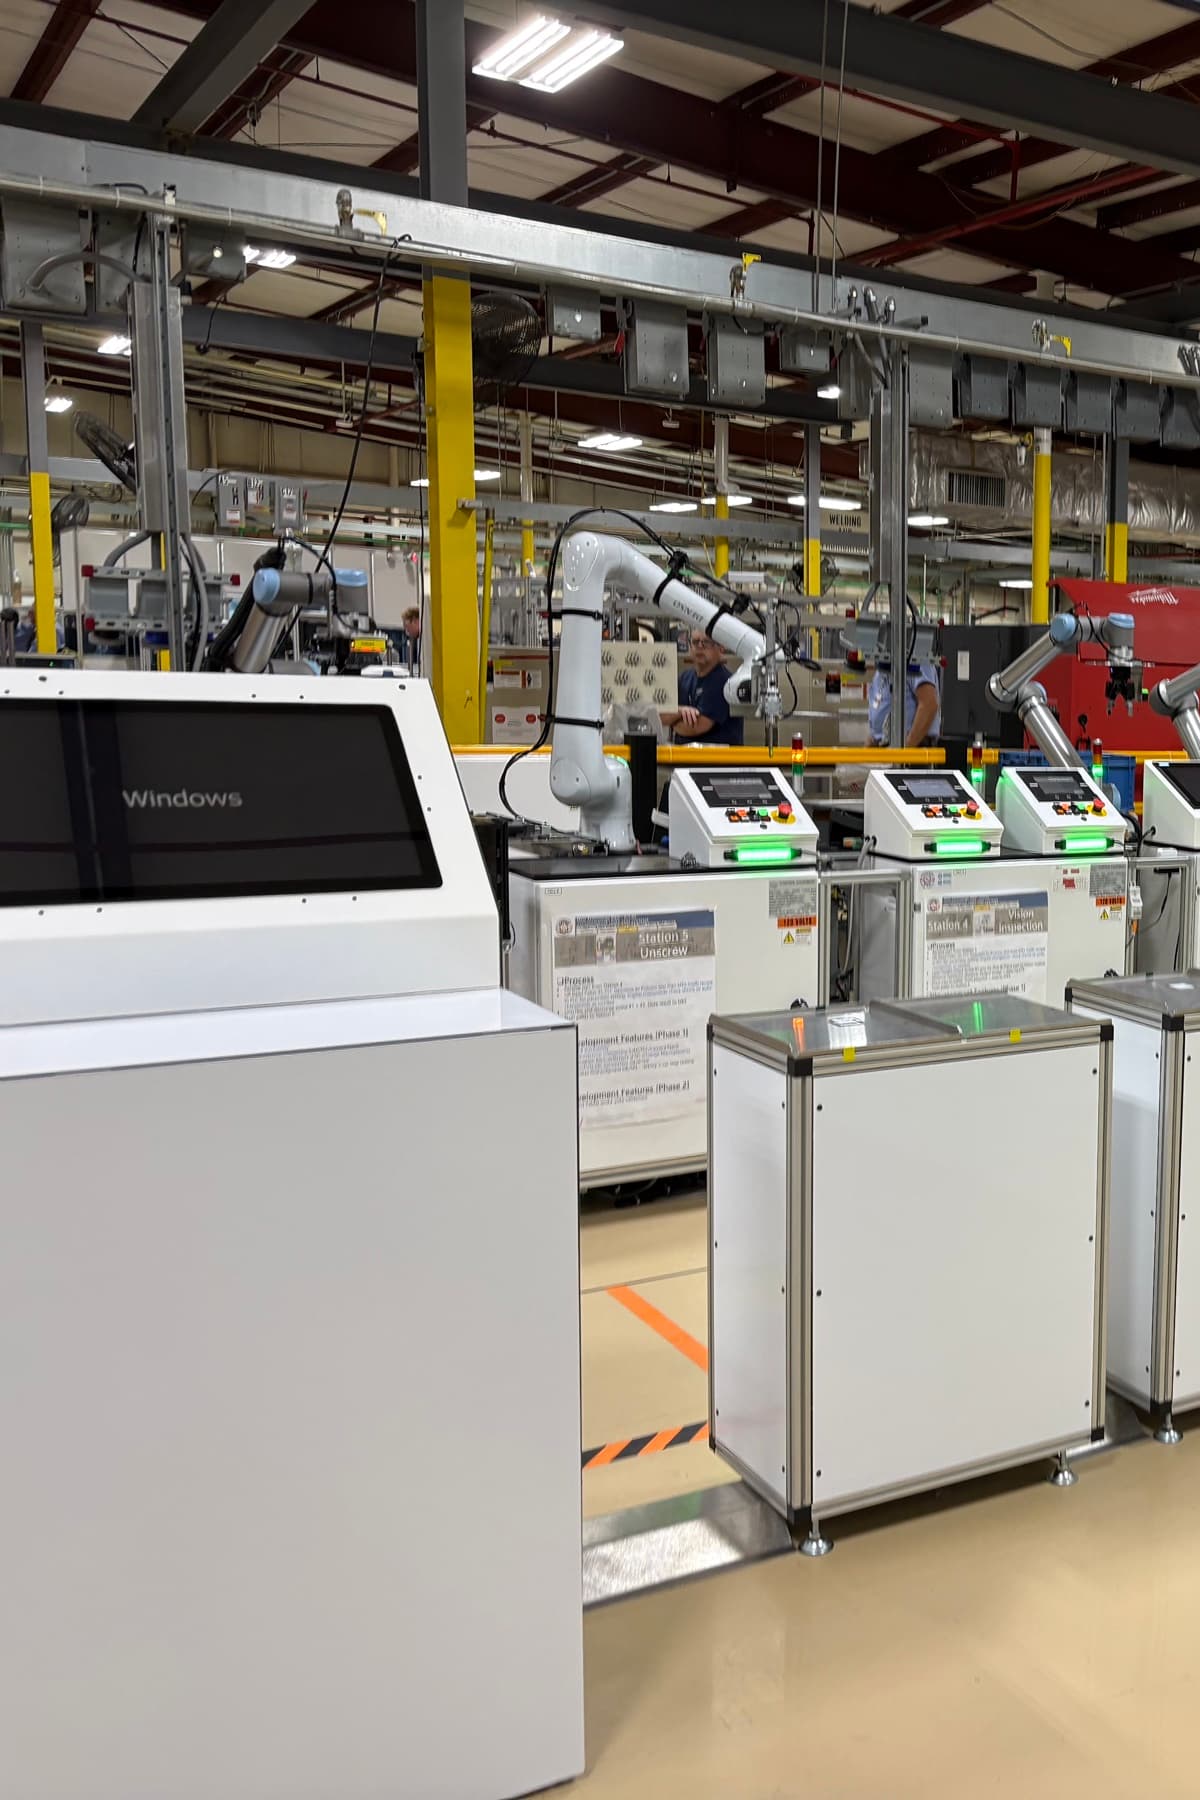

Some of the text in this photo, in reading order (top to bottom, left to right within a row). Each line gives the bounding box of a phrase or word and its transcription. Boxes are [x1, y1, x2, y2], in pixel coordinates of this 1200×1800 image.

[829, 513, 861, 527] WELDING
[122, 788, 243, 808] Windows
[1008, 908, 1034, 919] Vision
[928, 919, 959, 932] Station
[1000, 920, 1043, 933] Inspection
[638, 928, 679, 945] Station
[640, 946, 689, 959] Unscrew
